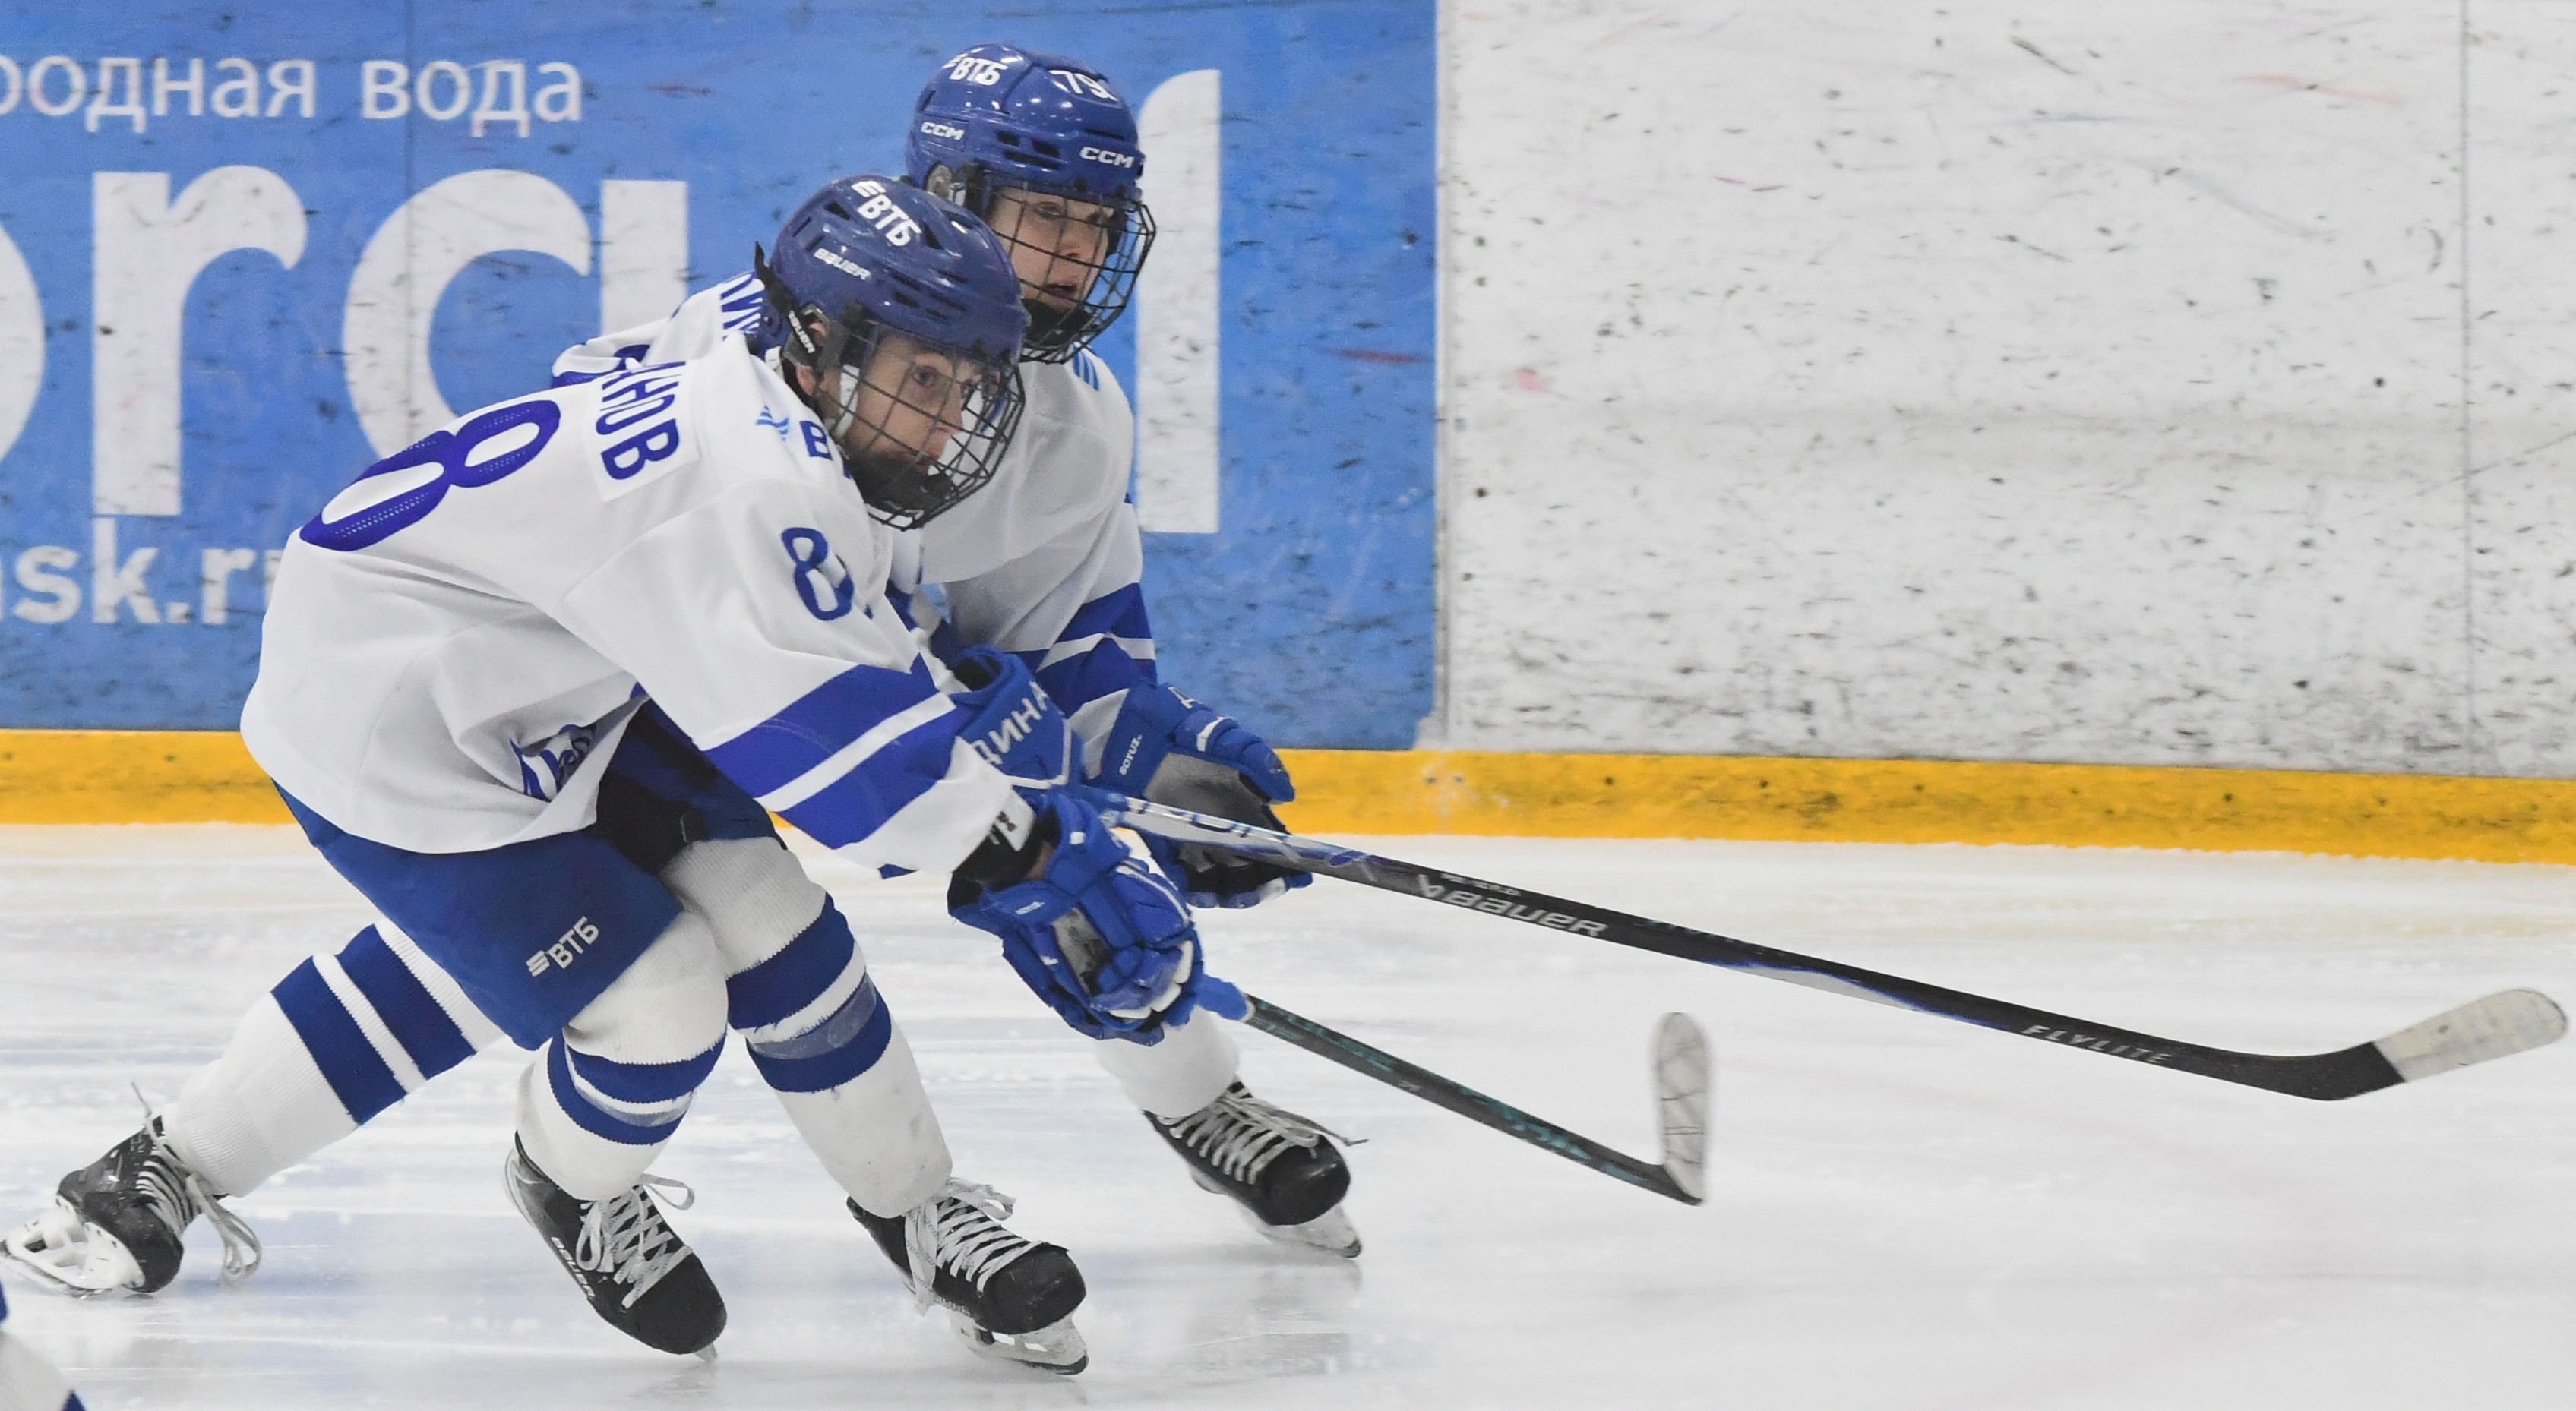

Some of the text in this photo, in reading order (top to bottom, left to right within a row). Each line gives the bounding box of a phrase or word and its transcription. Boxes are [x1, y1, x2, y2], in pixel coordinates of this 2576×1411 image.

[949, 57, 1009, 86] ВТБ
[361, 59, 583, 139] вода
[920, 122, 966, 141] CCM
[1079, 146, 1136, 169] CCM
[856, 194, 923, 247] ВТБ
[547, 914, 600, 970] ВТБ
[2021, 1024, 2173, 1064] FLYLITE
